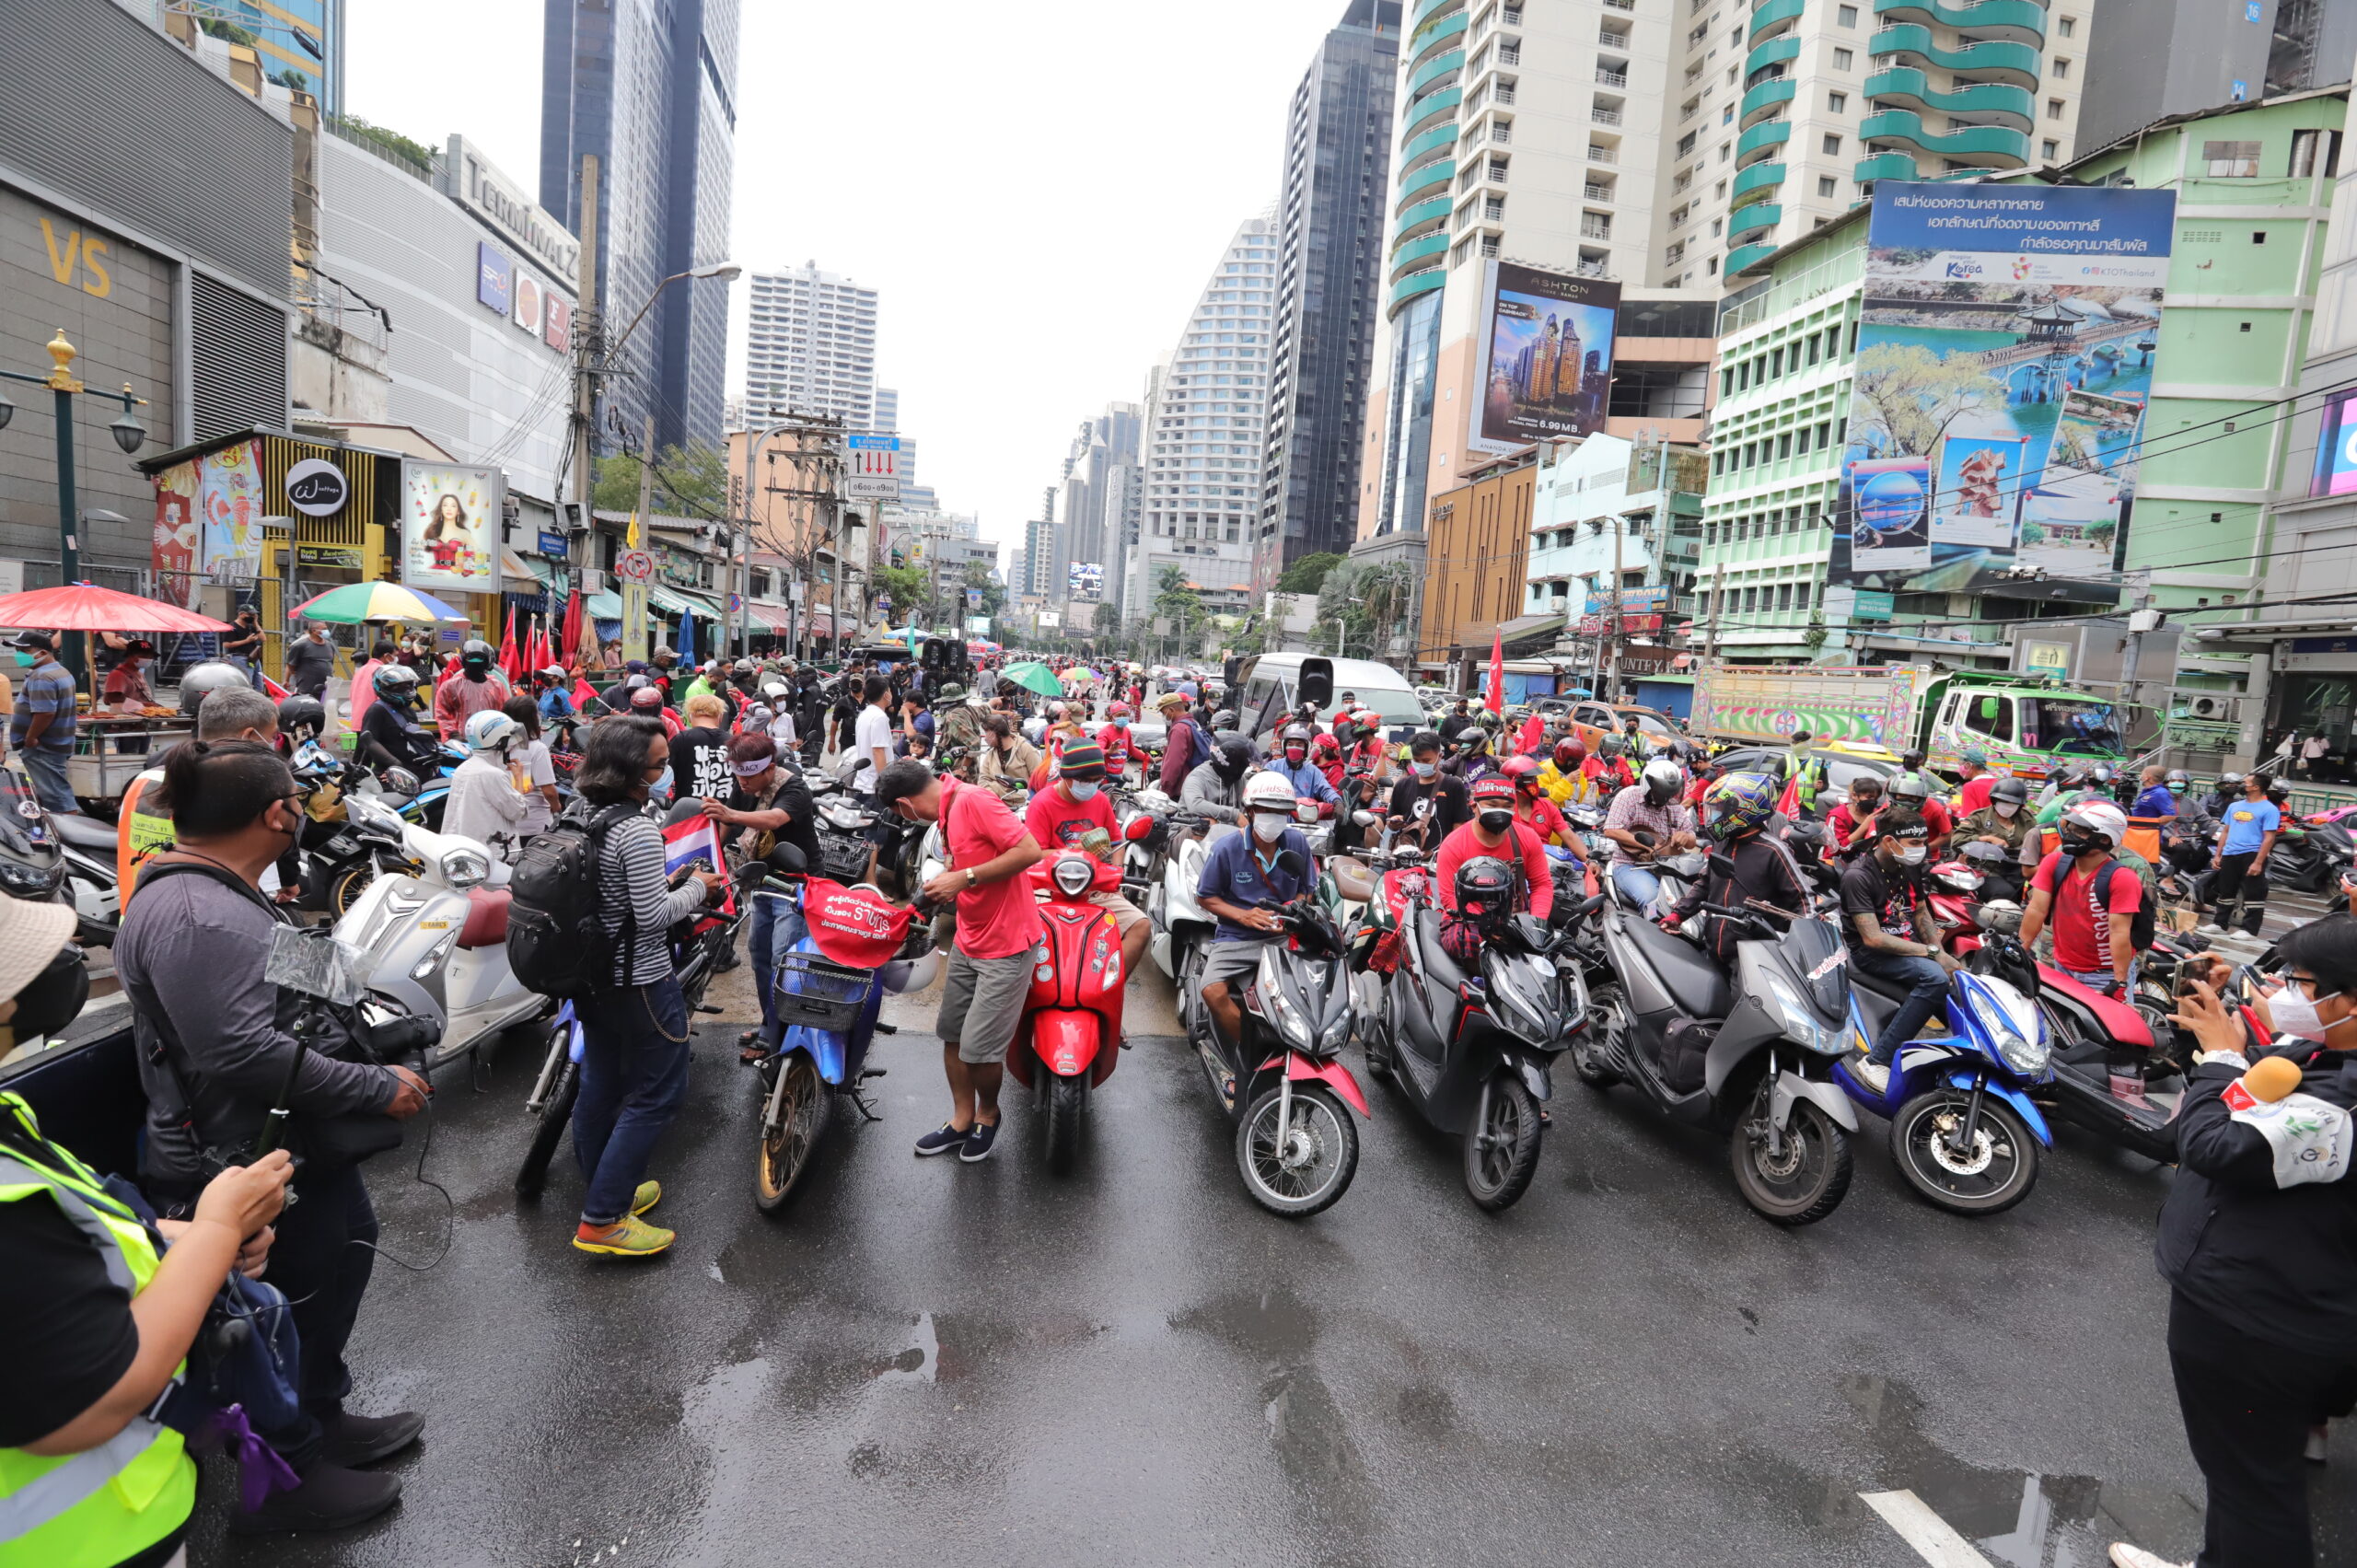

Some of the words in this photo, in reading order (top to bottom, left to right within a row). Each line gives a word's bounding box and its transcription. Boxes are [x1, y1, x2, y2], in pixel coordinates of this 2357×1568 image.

[1894, 194, 2044, 211] เสน่ห์ของความหลากหลาย
[2020, 236, 2148, 253] กำลังรอคุณมาสัมผัส
[39, 217, 110, 297] VS
[1531, 277, 1589, 294] ASHTON
[1539, 420, 1560, 430] 6.99
[1480, 443, 1507, 452] ANANDA
[1603, 655, 1663, 675] CUNTRY
